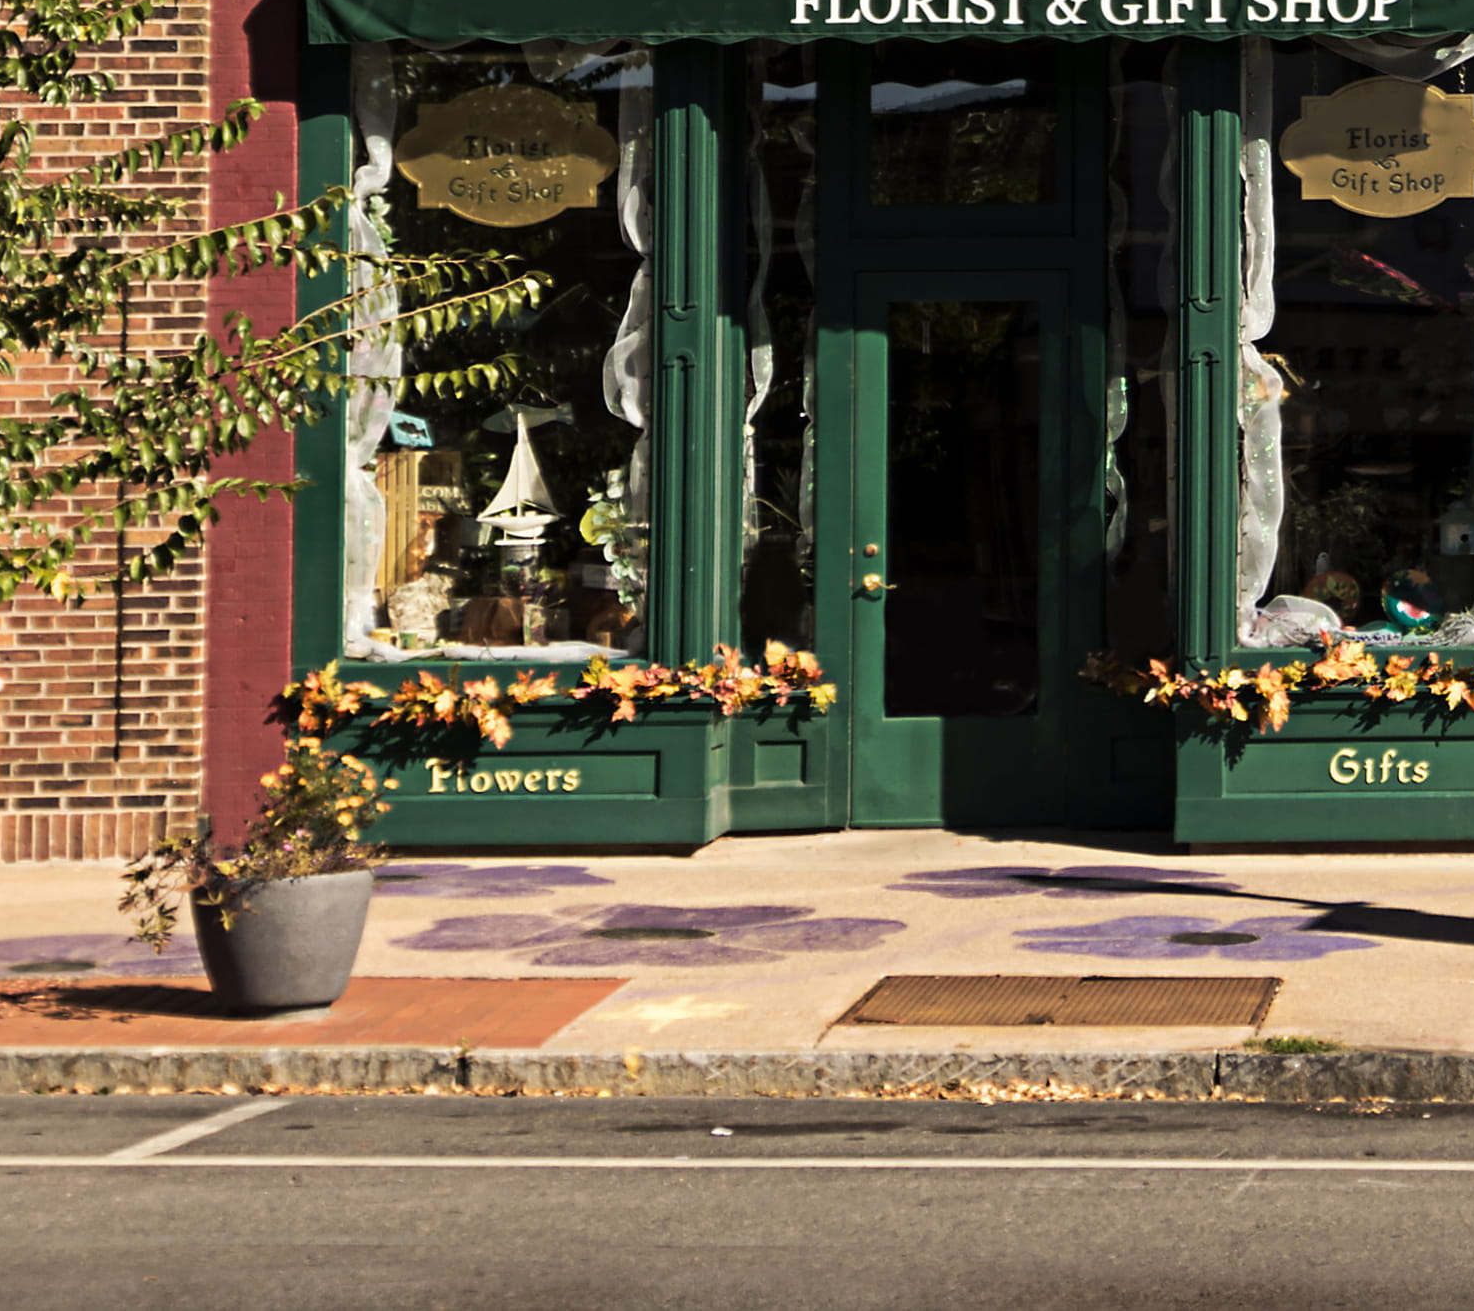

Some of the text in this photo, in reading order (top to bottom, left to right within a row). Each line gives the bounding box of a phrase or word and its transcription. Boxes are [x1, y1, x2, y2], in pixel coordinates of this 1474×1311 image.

[463, 135, 551, 157] Florist
[1345, 126, 1431, 150] Florist
[448, 176, 565, 204] Gift Shop
[1332, 167, 1445, 196] Gift Shop
[425, 757, 580, 793] Flowers
[1328, 747, 1431, 784] Gifts
